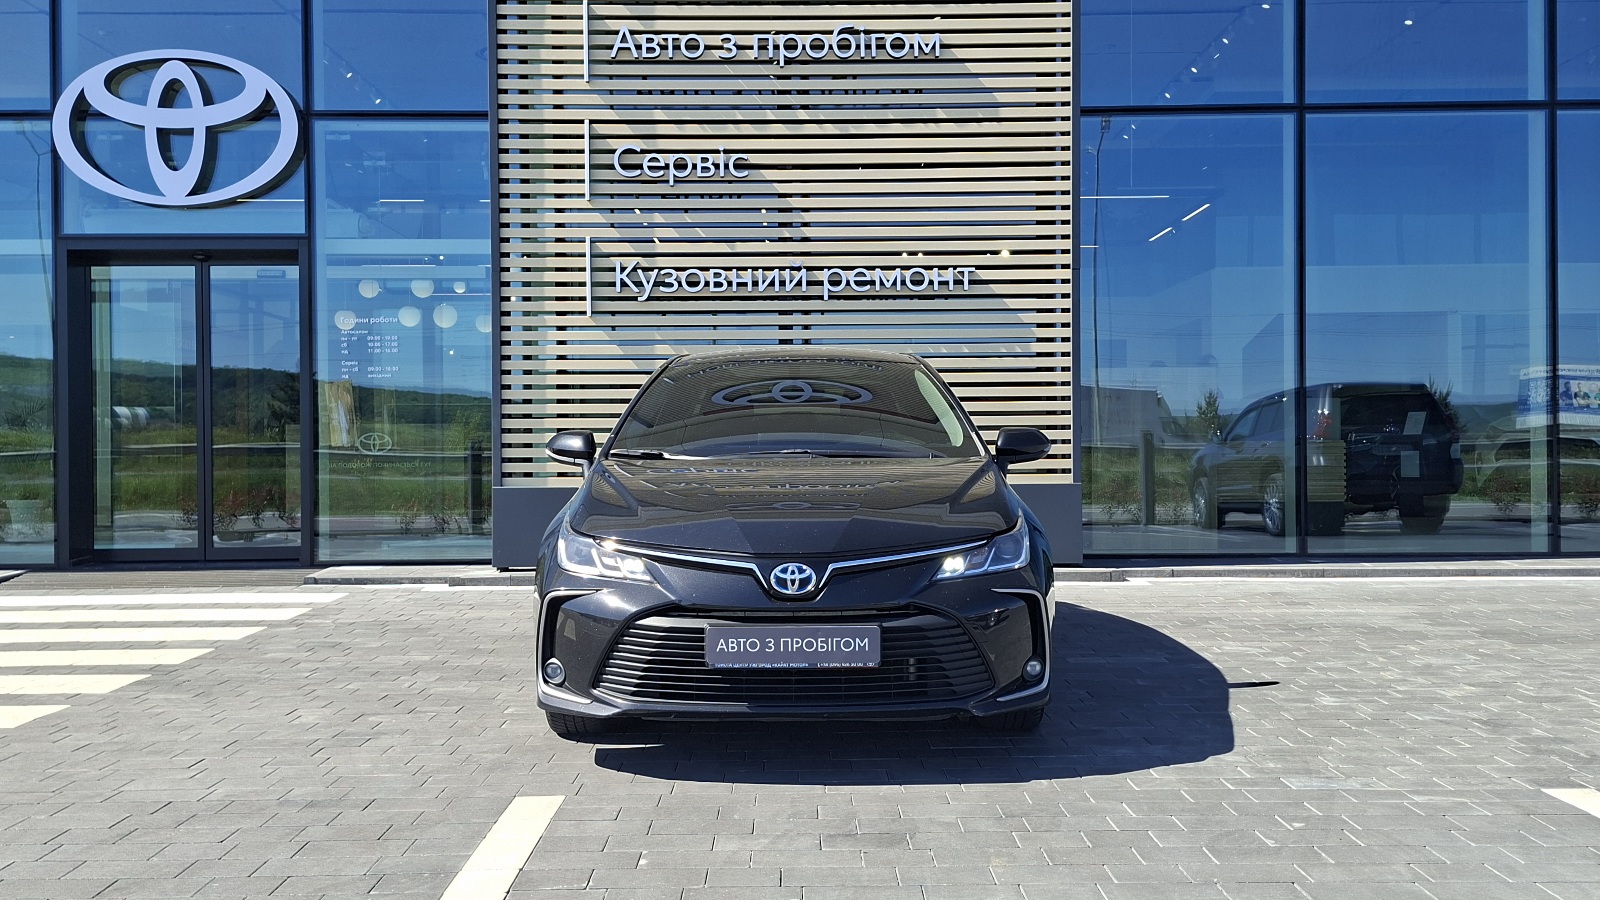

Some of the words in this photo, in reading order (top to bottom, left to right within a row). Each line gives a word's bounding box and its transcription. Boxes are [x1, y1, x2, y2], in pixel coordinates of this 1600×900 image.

[610, 26, 705, 60] Авто
[717, 33, 738, 60] з
[753, 24, 941, 67] пробігом
[613, 145, 750, 186] Сервіс
[614, 259, 808, 302] Кузовний
[823, 266, 976, 302] ремонт
[340, 316, 368, 324] Години
[370, 315, 398, 324] роботи
[716, 638, 760, 652] АВТО
[765, 638, 775, 652] З
[780, 637, 869, 652] ПРОБІГОМ
